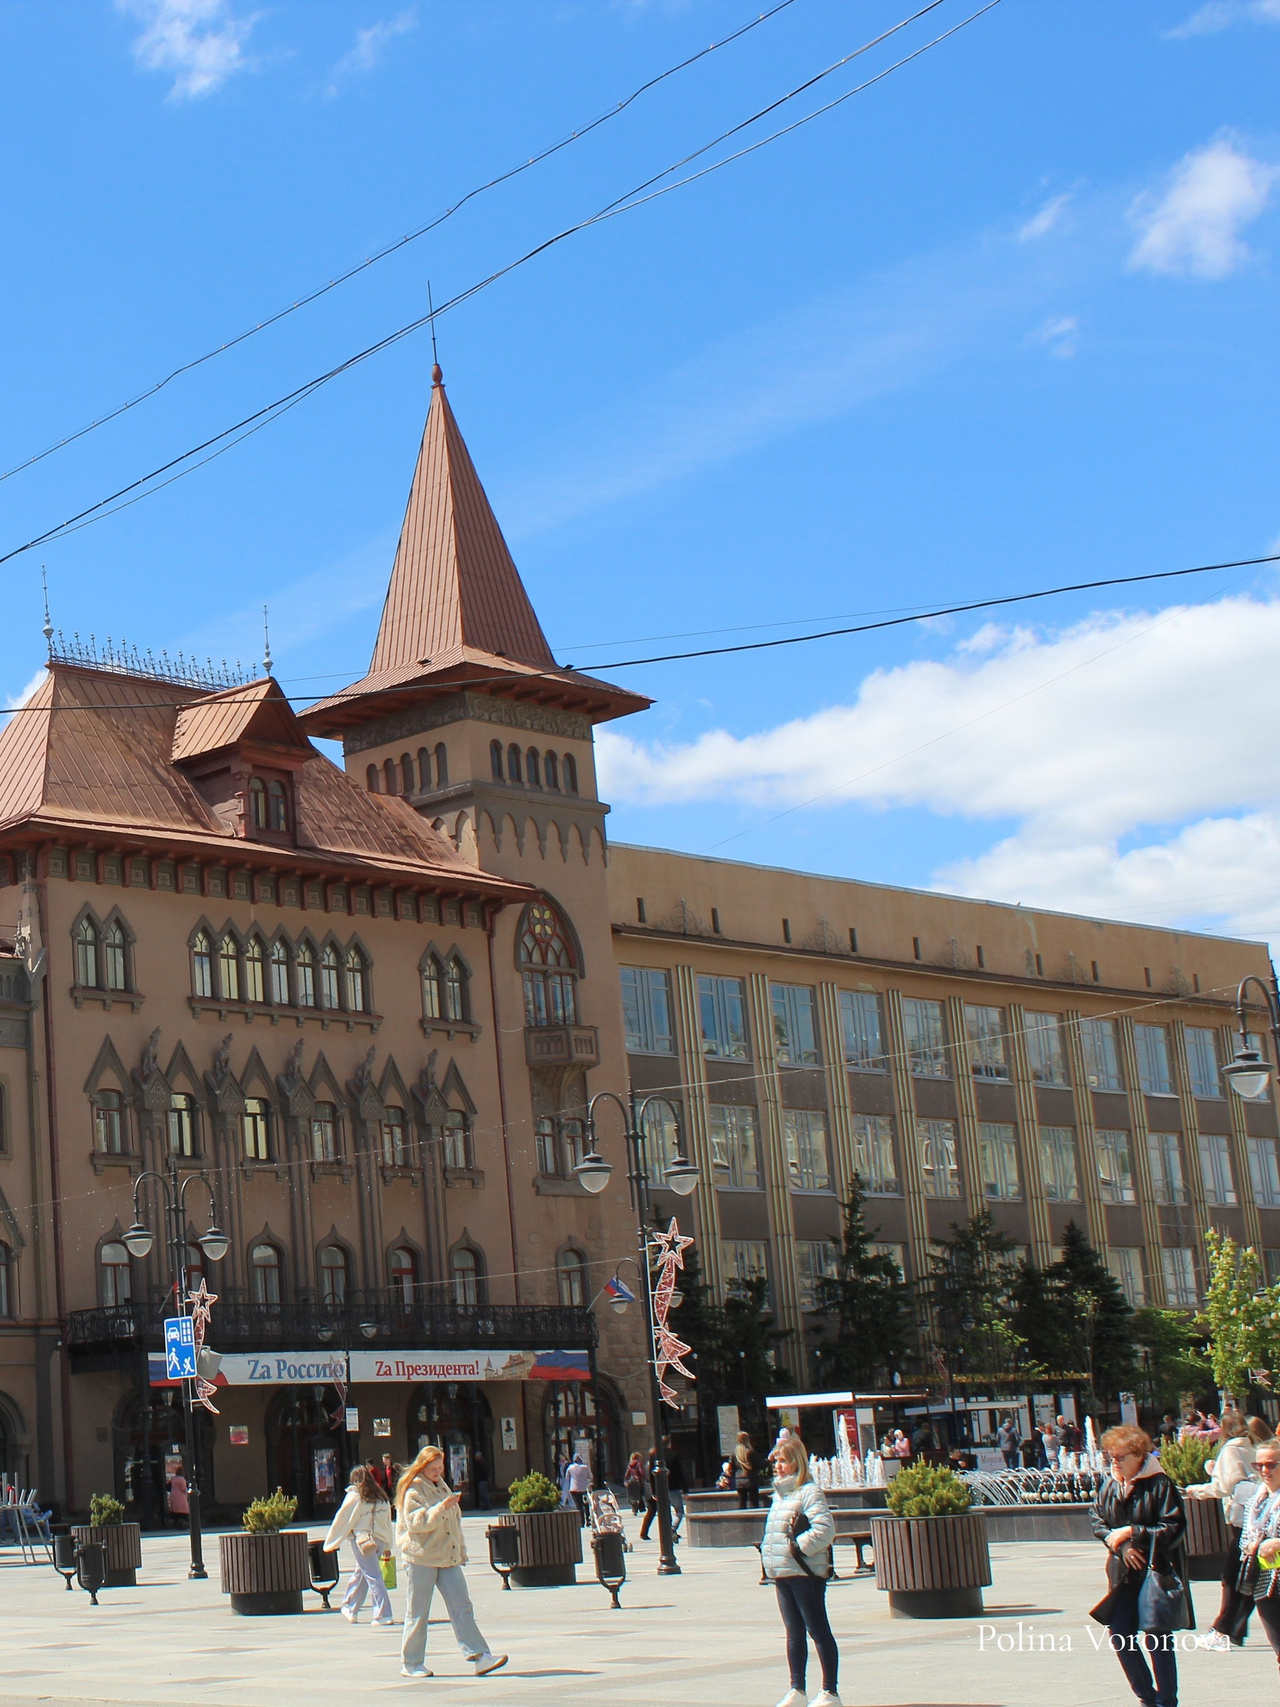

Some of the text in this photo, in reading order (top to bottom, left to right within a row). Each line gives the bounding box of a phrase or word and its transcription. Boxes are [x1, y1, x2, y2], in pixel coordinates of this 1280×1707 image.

[247, 1358, 345, 1380] Za Россию
[375, 1360, 479, 1380] Za Президента!
